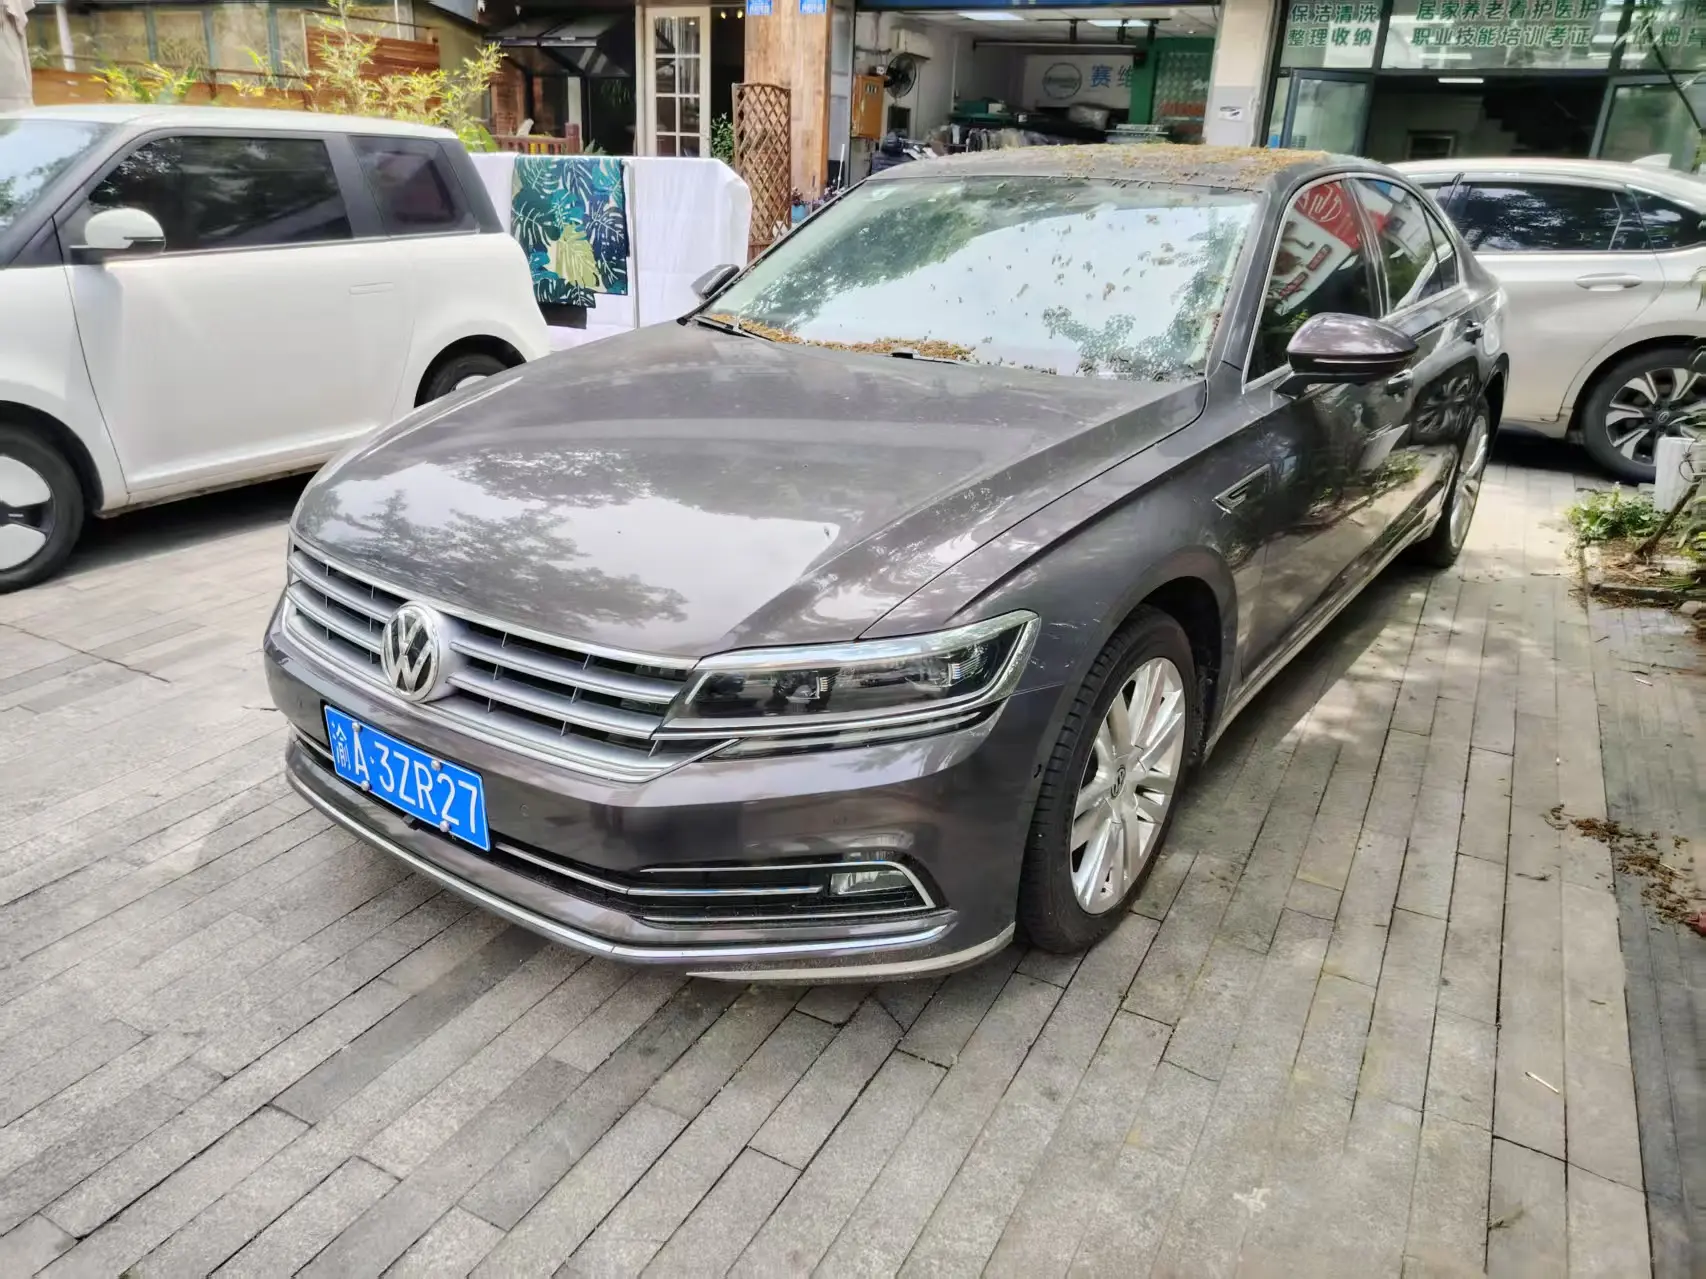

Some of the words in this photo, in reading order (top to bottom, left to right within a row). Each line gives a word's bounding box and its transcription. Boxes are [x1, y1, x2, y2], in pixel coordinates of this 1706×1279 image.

[1290, 3, 1378, 24] 保洁清洗
[1415, 0, 1600, 21] 居家养老看护医护
[1287, 27, 1373, 47] 整理收纳
[1411, 27, 1593, 47] 职业技能培训考证
